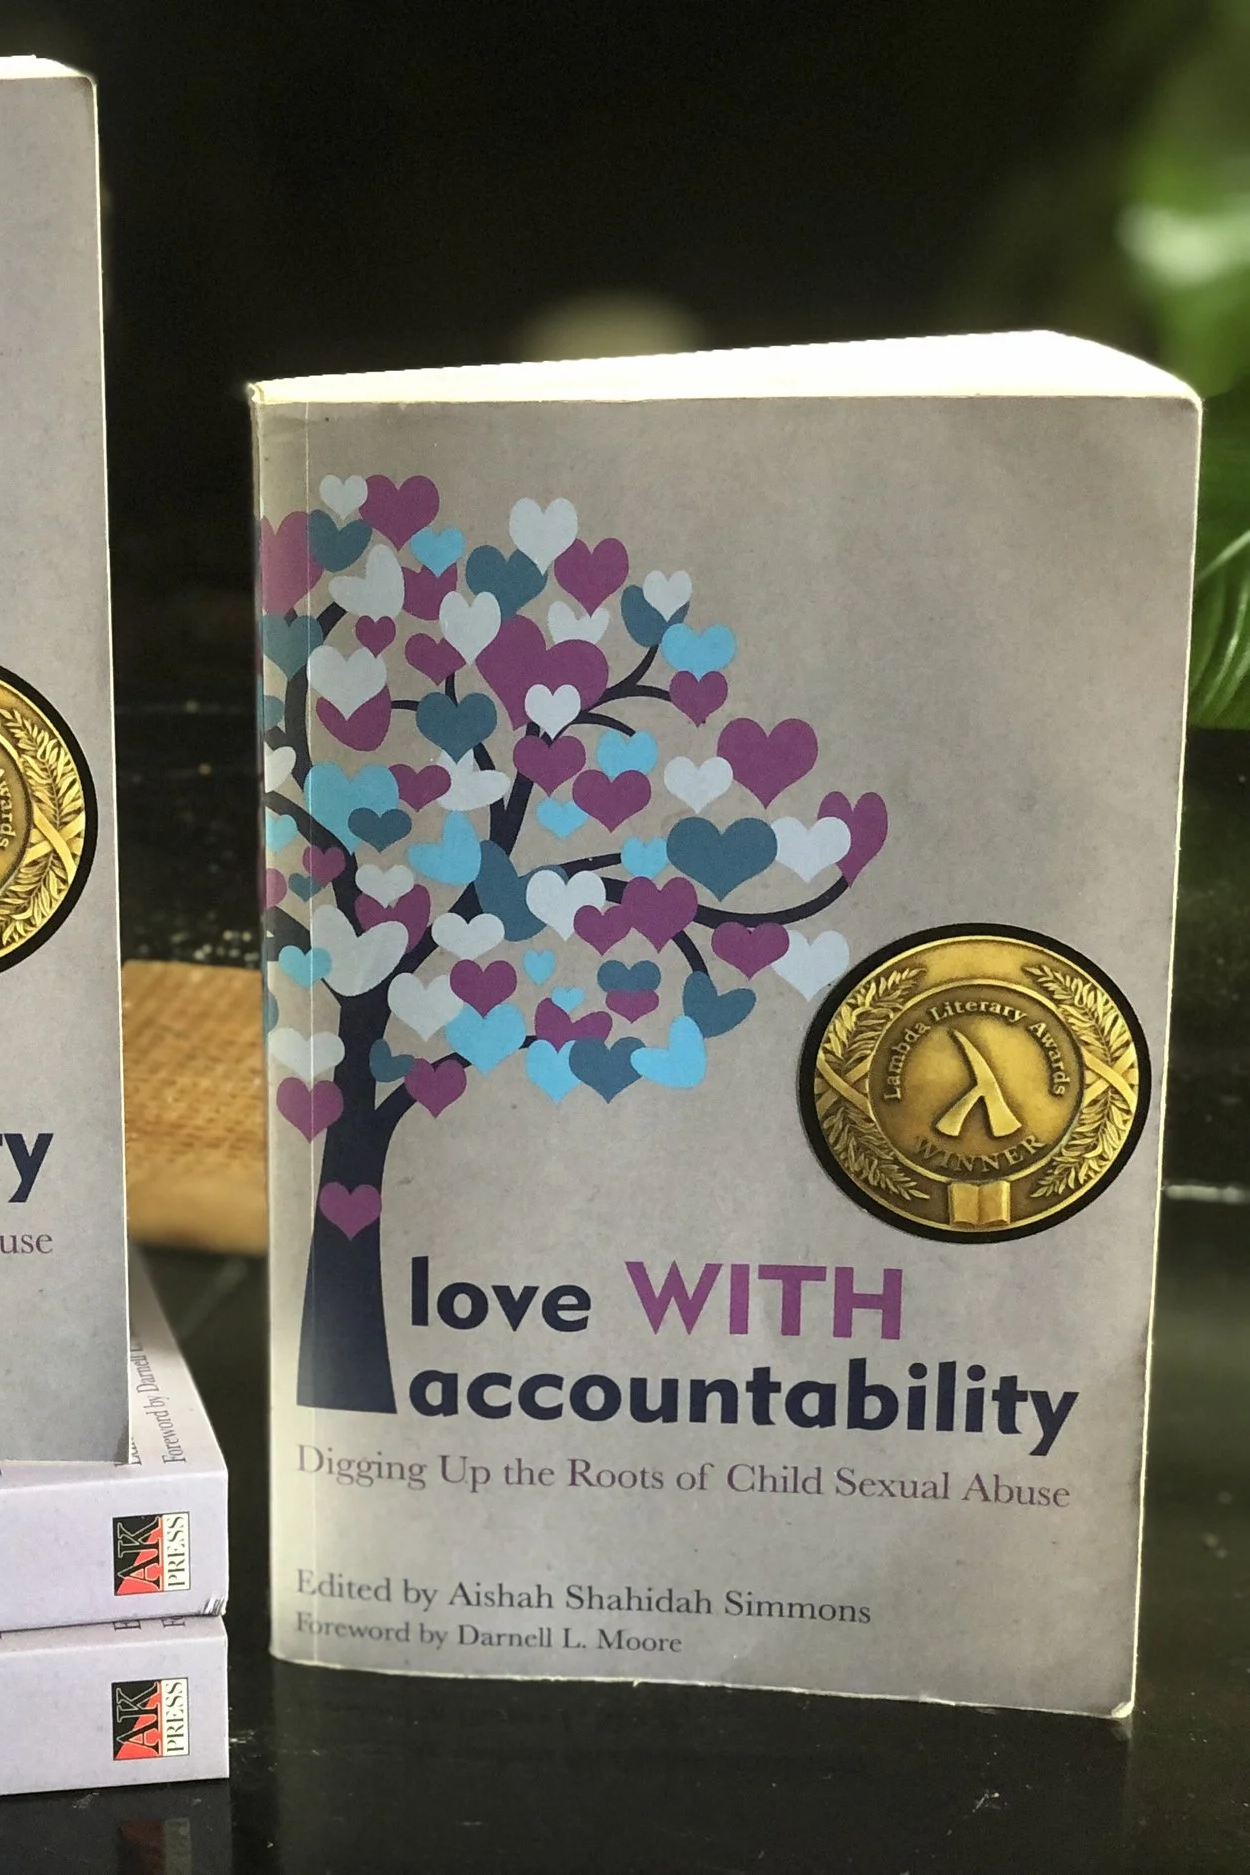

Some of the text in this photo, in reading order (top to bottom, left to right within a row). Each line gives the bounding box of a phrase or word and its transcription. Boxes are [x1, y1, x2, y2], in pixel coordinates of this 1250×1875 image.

[884, 1000, 1070, 1100] Lambda Literary Awards
[916, 1134, 1046, 1172] WINNER
[412, 1256, 903, 1340] love WITH
[143, 1395, 170, 1409] by
[145, 1410, 187, 1464] Foreword
[409, 1358, 1079, 1456] accountability
[296, 1444, 1069, 1507] Digging Up the Roots of Child Sexual Abuse
[116, 1516, 164, 1595] AK
[167, 1516, 188, 1586] PRESS
[296, 1569, 870, 1624] Edited by Aishah Shahidah Simmons
[296, 1611, 682, 1652] Foreword by Darnell L. Moore
[114, 1680, 161, 1757] AK
[166, 1681, 186, 1755] PRESS
